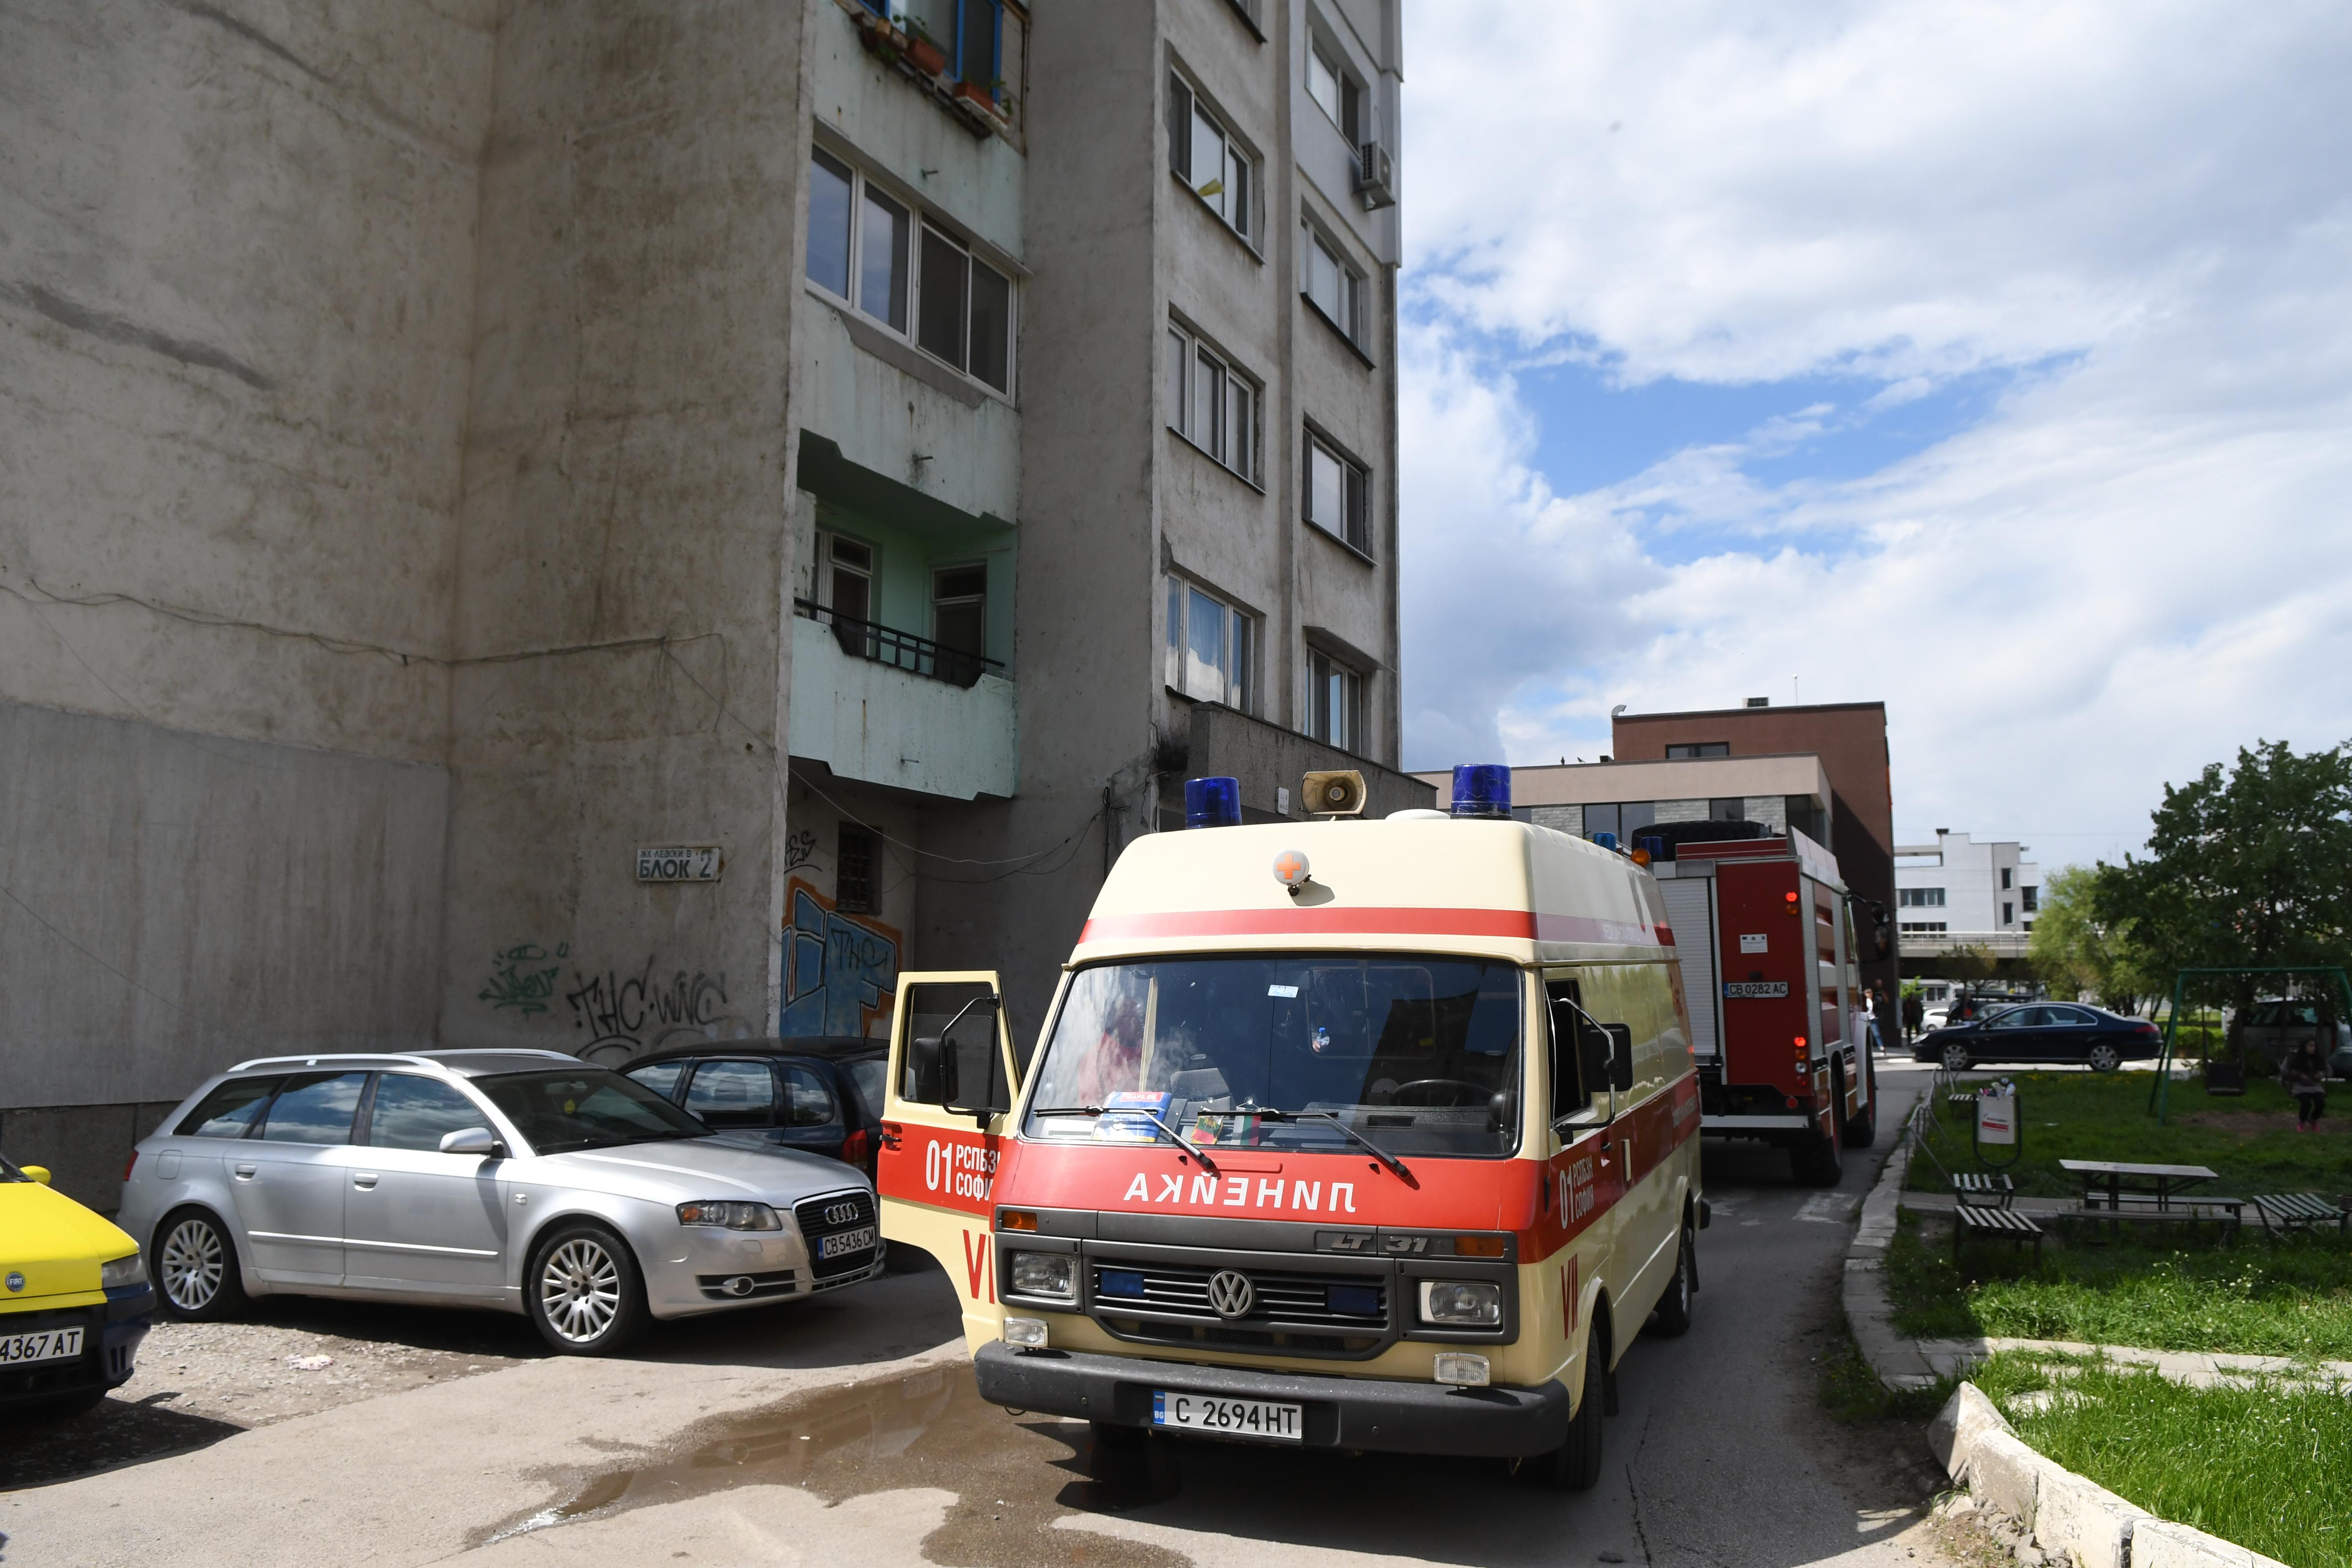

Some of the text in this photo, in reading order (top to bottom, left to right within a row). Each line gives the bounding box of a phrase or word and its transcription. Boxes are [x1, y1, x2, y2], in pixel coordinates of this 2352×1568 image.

[639, 850, 713, 878] БЛОК 2
[1730, 984, 1786, 994] CB 0282 AC
[926, 1140, 953, 1193] 01
[1573, 1155, 1593, 1189] РСПБЗН
[1560, 1165, 1574, 1229] 01
[1575, 1184, 1594, 1219] СОФИЯ
[825, 1228, 874, 1255] CB 5436 CM
[1331, 1233, 1429, 1252] LT 31
[1560, 1253, 1578, 1340] VII
[0, 1331, 80, 1361] 4367 AT
[1154, 1411, 1164, 1419] BG
[1176, 1398, 1297, 1433] C 2694 HT
